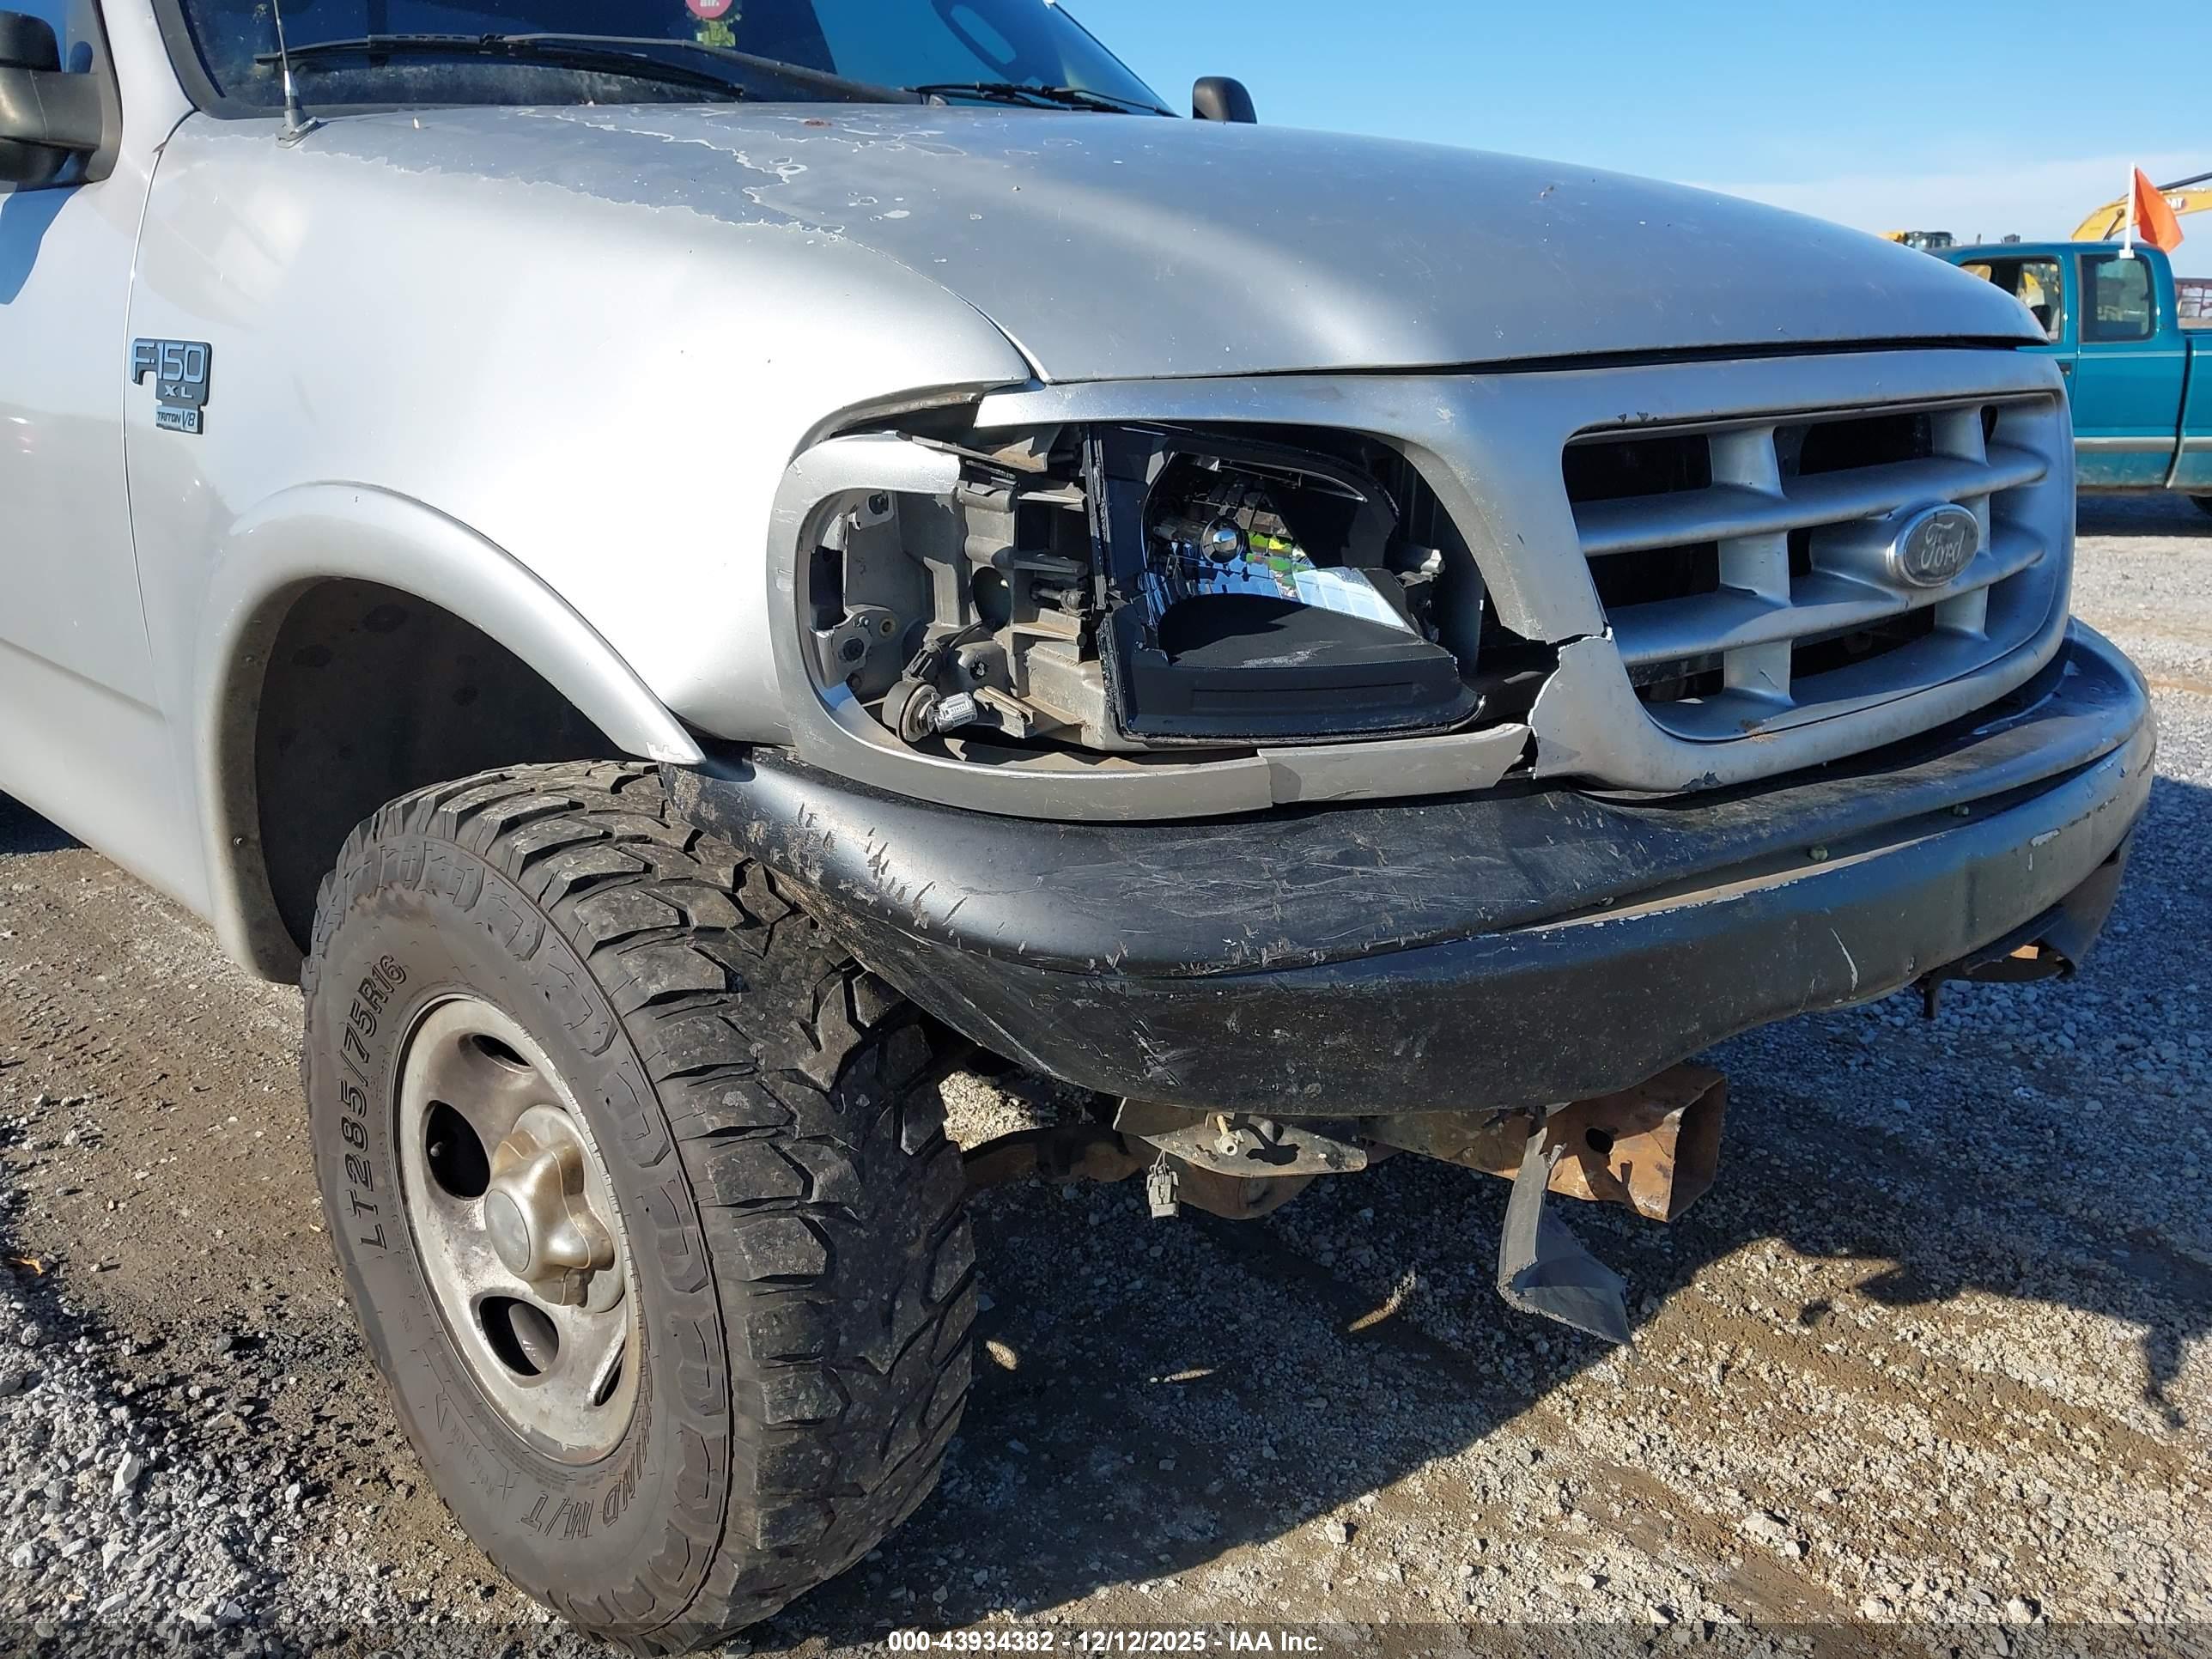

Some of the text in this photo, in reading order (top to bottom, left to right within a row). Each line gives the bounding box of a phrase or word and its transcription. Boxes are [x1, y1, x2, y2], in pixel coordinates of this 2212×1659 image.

[164, 385, 194, 398] XL
[157, 410, 196, 429] TRITON V8
[1920, 521, 1966, 570] Ford
